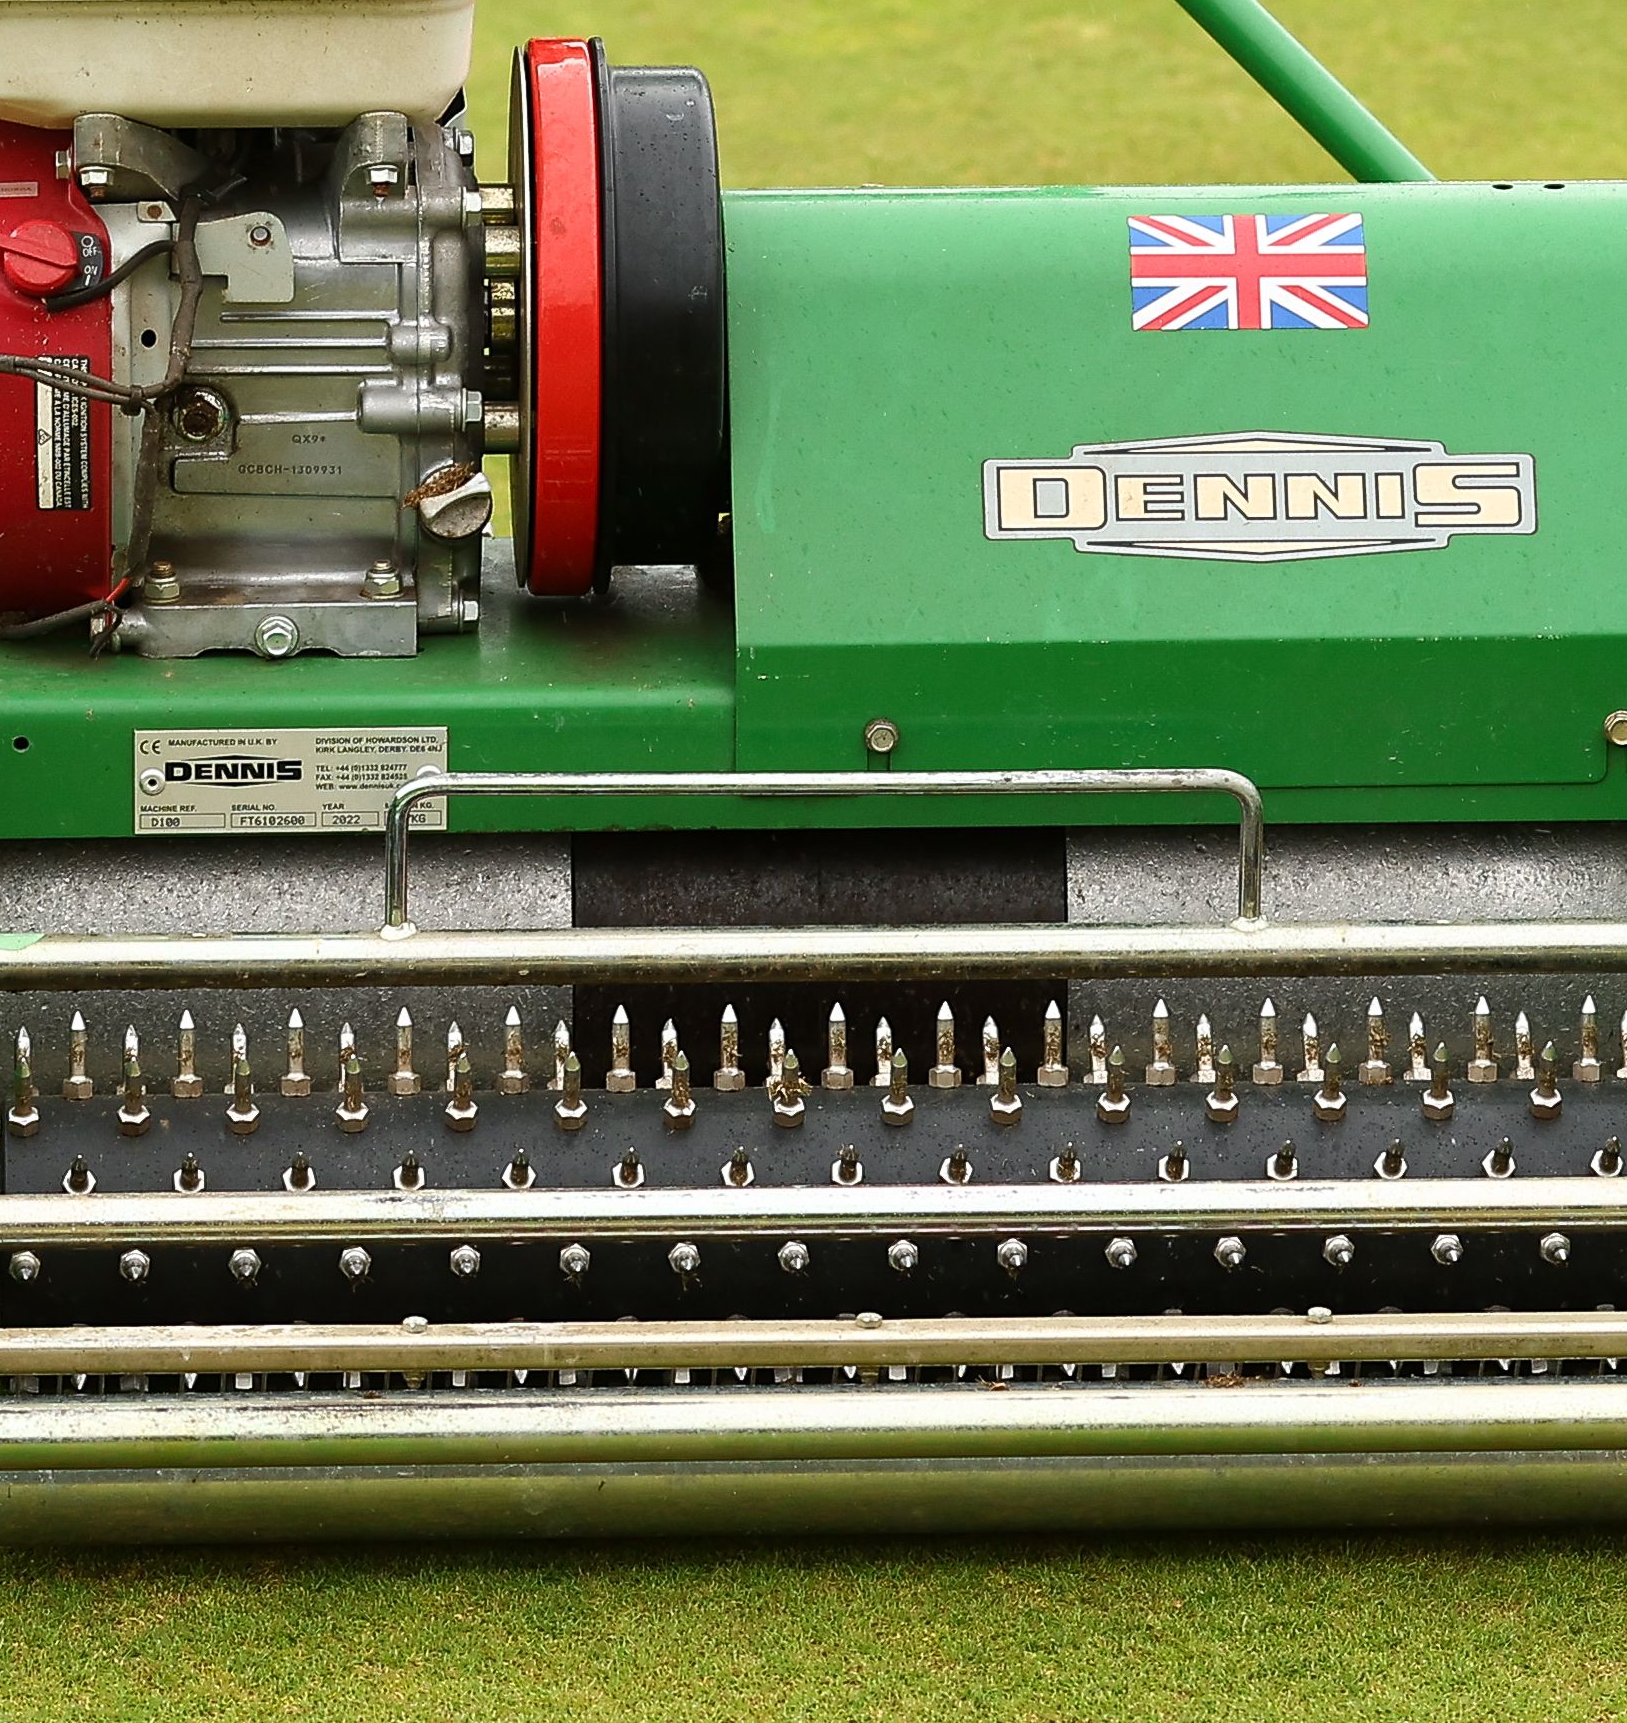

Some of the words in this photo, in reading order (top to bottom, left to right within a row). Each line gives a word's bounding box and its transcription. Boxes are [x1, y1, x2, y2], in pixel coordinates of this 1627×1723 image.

[82, 246, 97, 257] OFF
[84, 265, 98, 275] ON
[54, 407, 62, 416] LA
[54, 417, 62, 441] NORME
[80, 433, 88, 459] SYSTEM
[63, 448, 71, 462] PAR
[55, 471, 62, 480] DU
[55, 481, 63, 508] CANADA
[996, 461, 1522, 531] DENNIS
[63, 497, 72, 508] EST
[168, 738, 236, 747] MANUFACTURED
[237, 738, 246, 746] IN
[315, 737, 351, 745] DIVISION
[366, 736, 419, 744] HOWARDSON
[165, 760, 303, 782] DENNIS
[140, 804, 177, 812] MACHINE
[231, 804, 261, 812] SERIAL
[151, 817, 181, 827] D100
[333, 815, 361, 825] 2022
